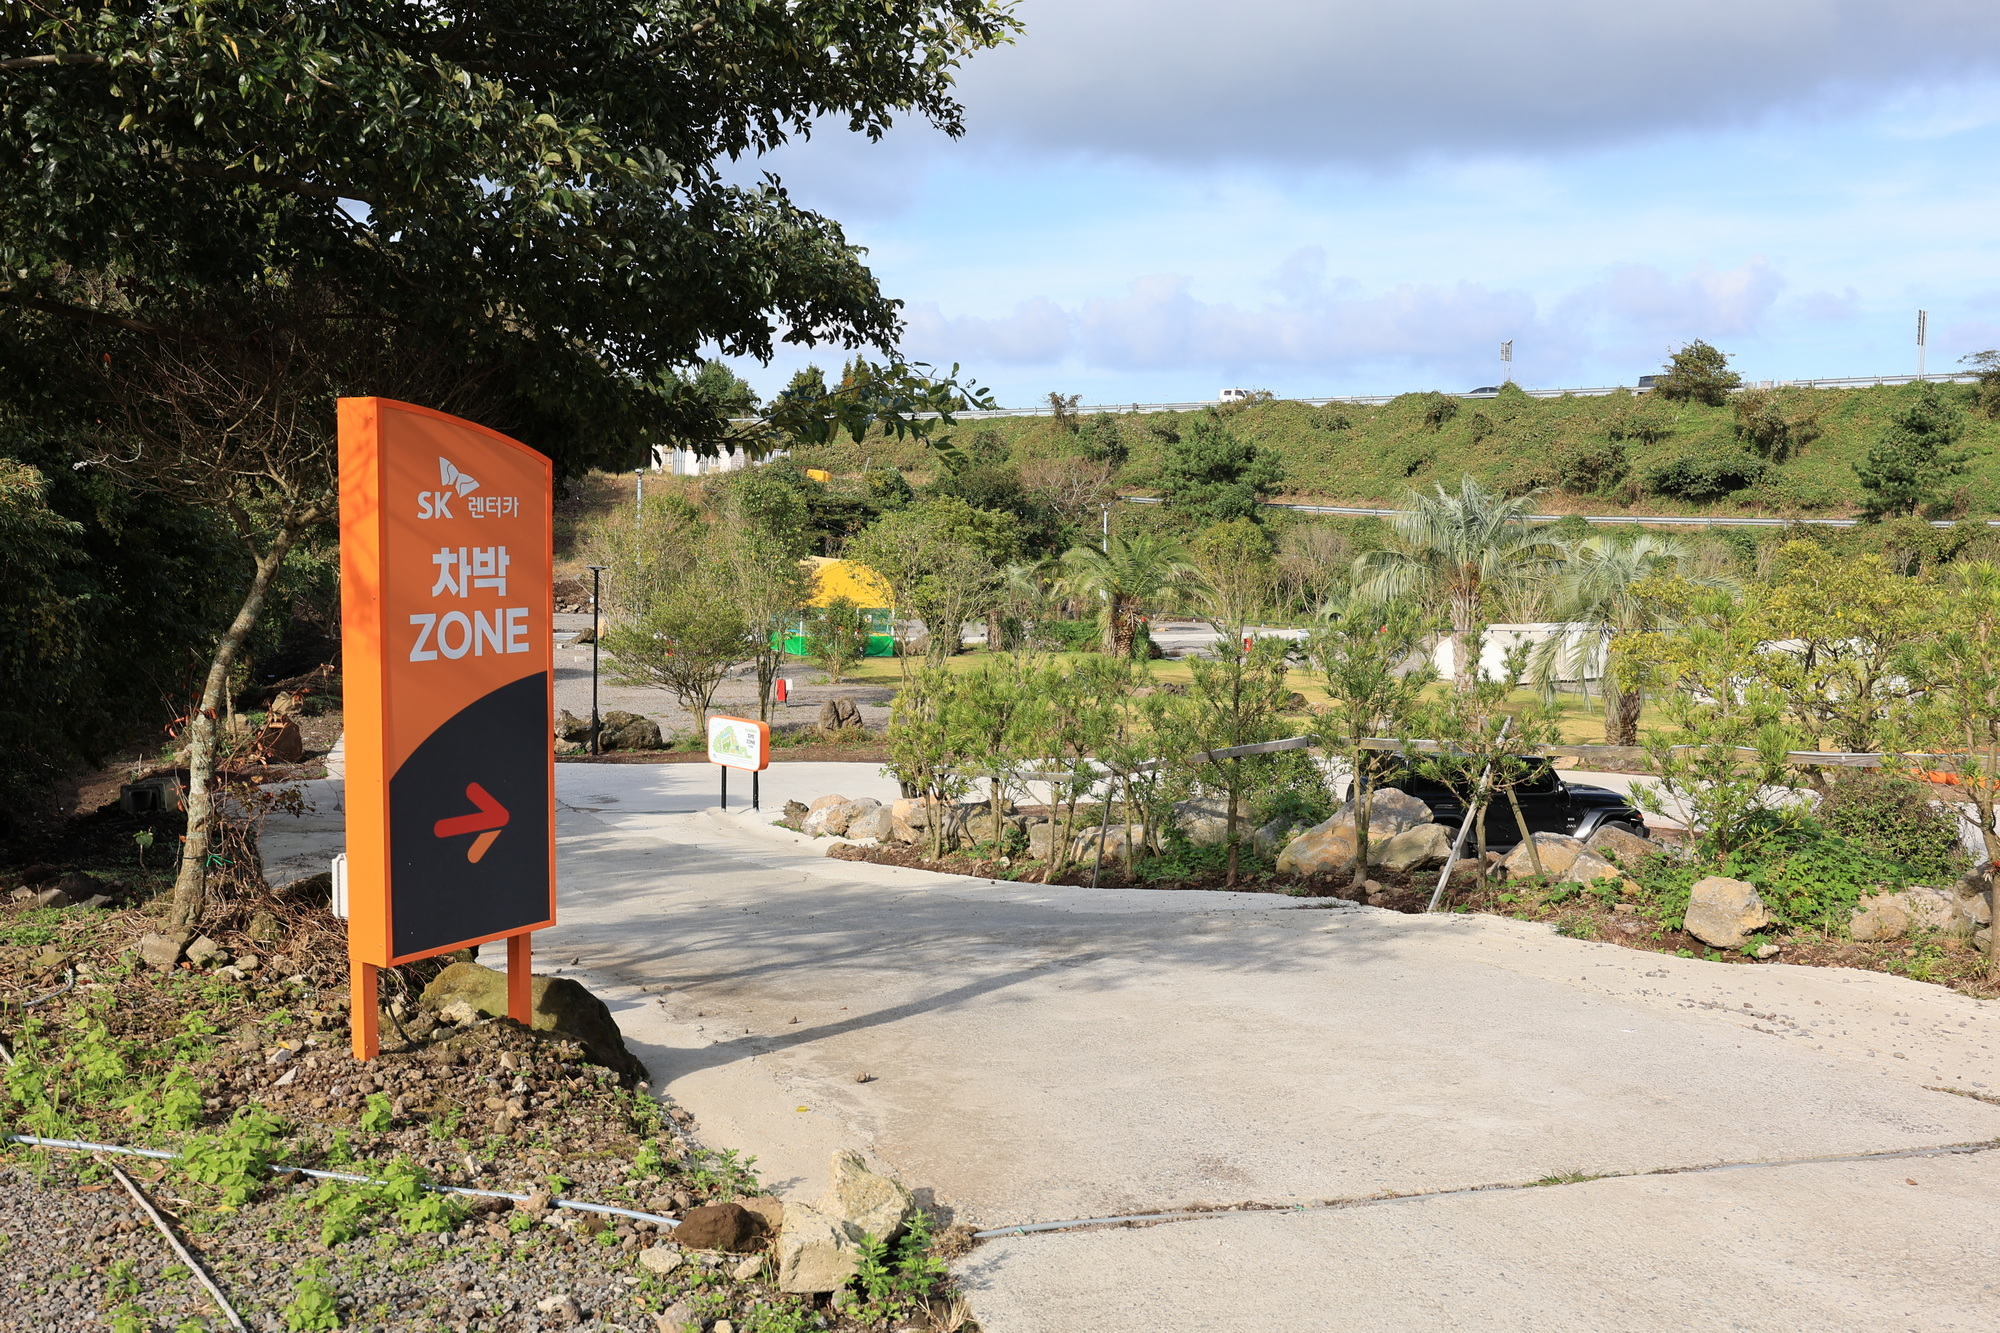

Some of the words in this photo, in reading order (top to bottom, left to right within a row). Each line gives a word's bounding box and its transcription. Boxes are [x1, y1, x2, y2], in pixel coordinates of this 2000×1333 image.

[417, 491, 454, 519] SK
[468, 496, 519, 519] 렌터카
[432, 546, 510, 598] 차박
[409, 607, 530, 662] ZONE
